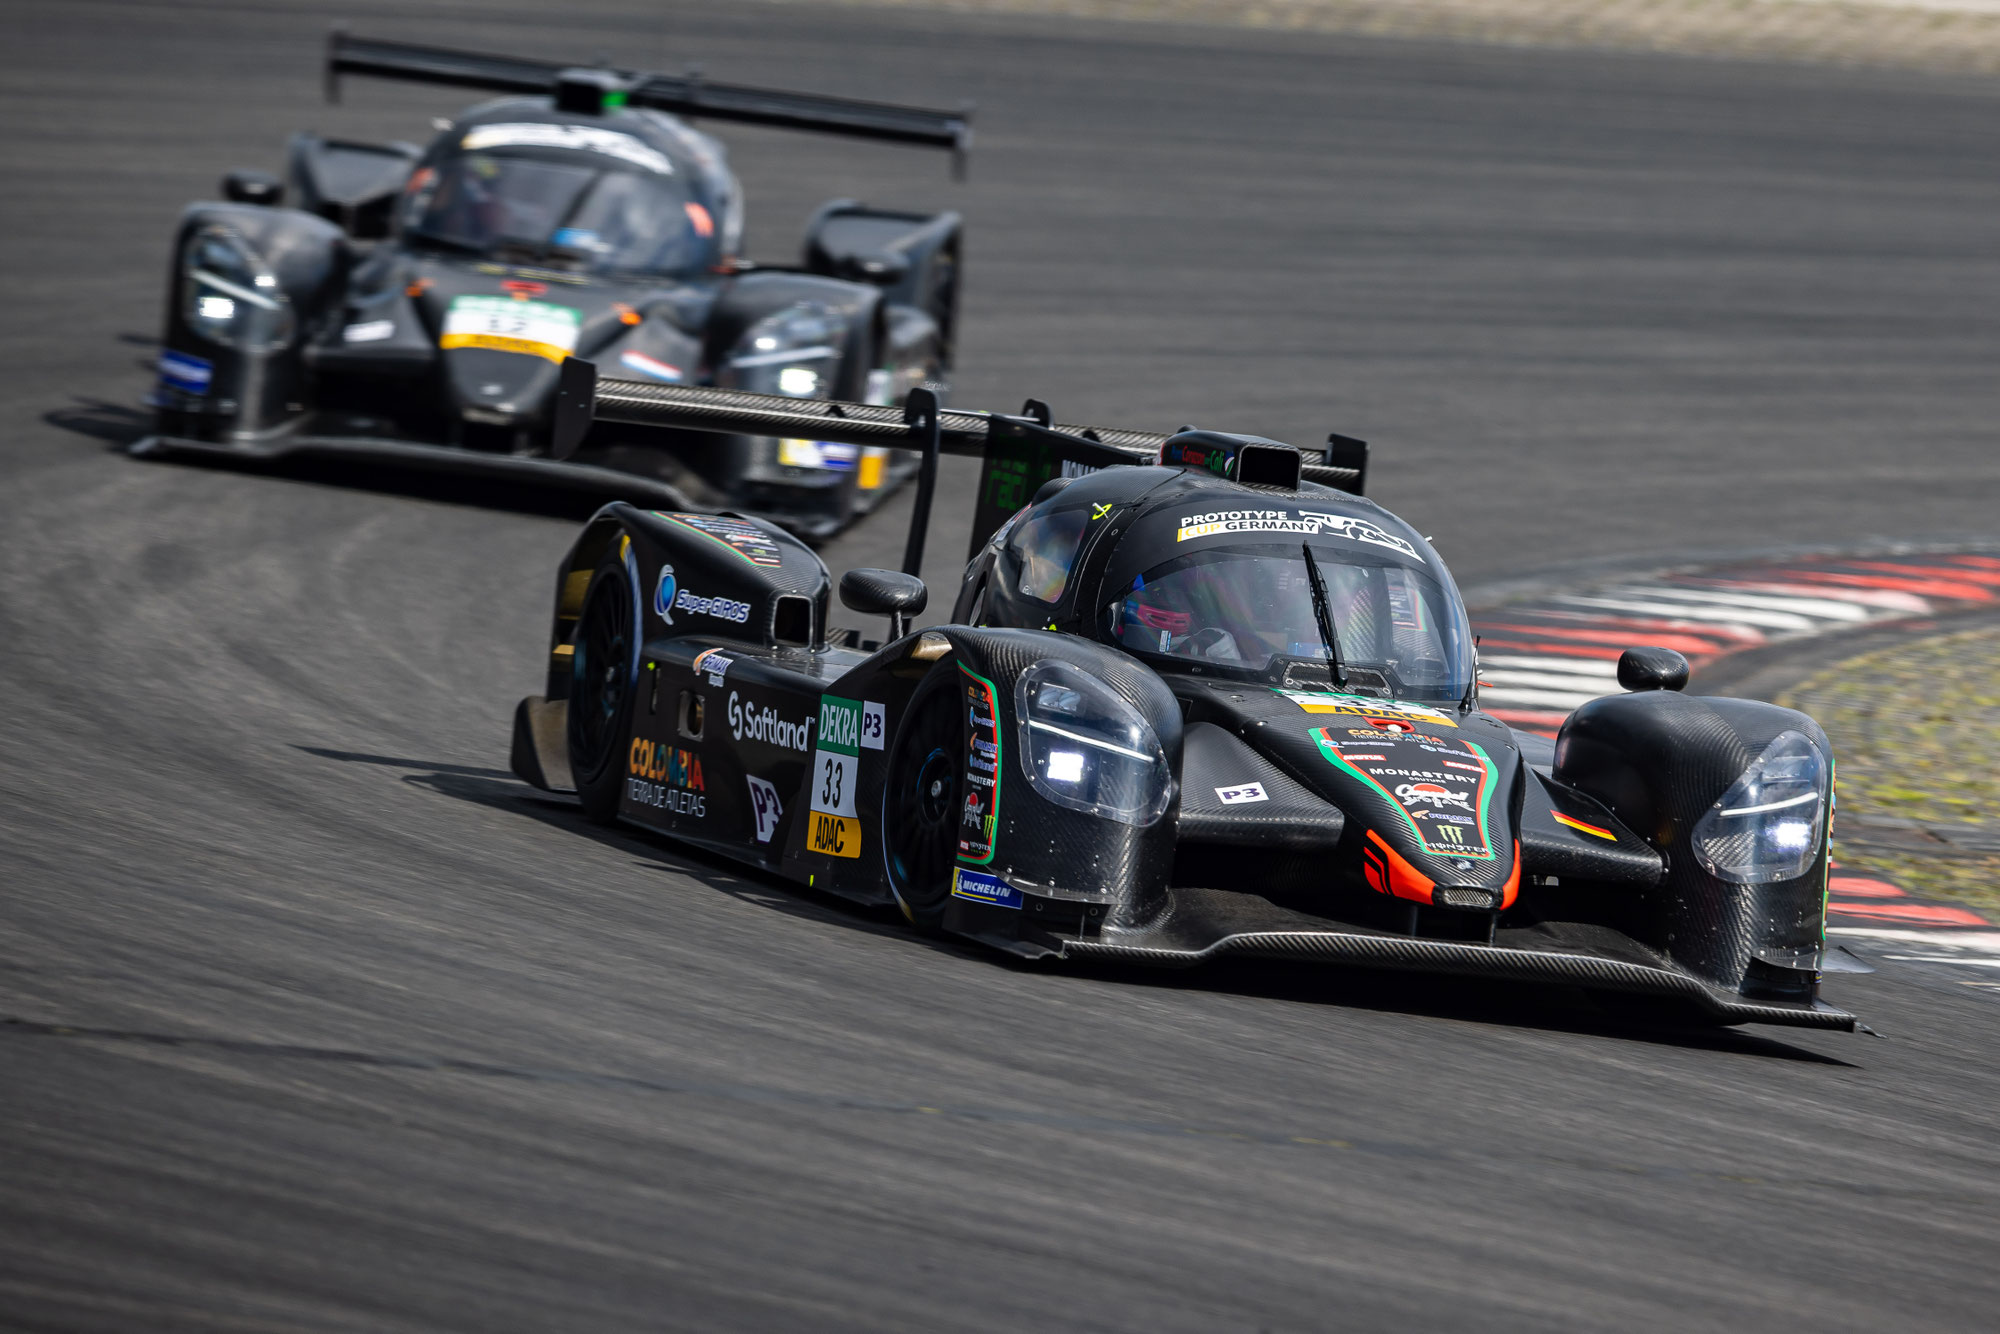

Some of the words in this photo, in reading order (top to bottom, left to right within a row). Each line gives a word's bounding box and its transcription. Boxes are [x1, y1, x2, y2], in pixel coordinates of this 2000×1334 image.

[1181, 510, 1288, 528] PROTOTYPE
[1185, 523, 1221, 538] CUP
[1225, 520, 1319, 532] GERMANY
[1334, 705, 1429, 721] ADAC
[819, 703, 859, 748] DEKRA
[863, 712, 882, 738] P3
[1348, 729, 1445, 744] COLOMBIA
[630, 737, 705, 791] COLOMBIA
[822, 758, 843, 809] 33
[1369, 768, 1477, 784] MONASTERY
[1222, 788, 1260, 799] P3
[750, 782, 782, 833] P3
[814, 816, 846, 854] ADAC
[963, 879, 1011, 898] MICHELIN
